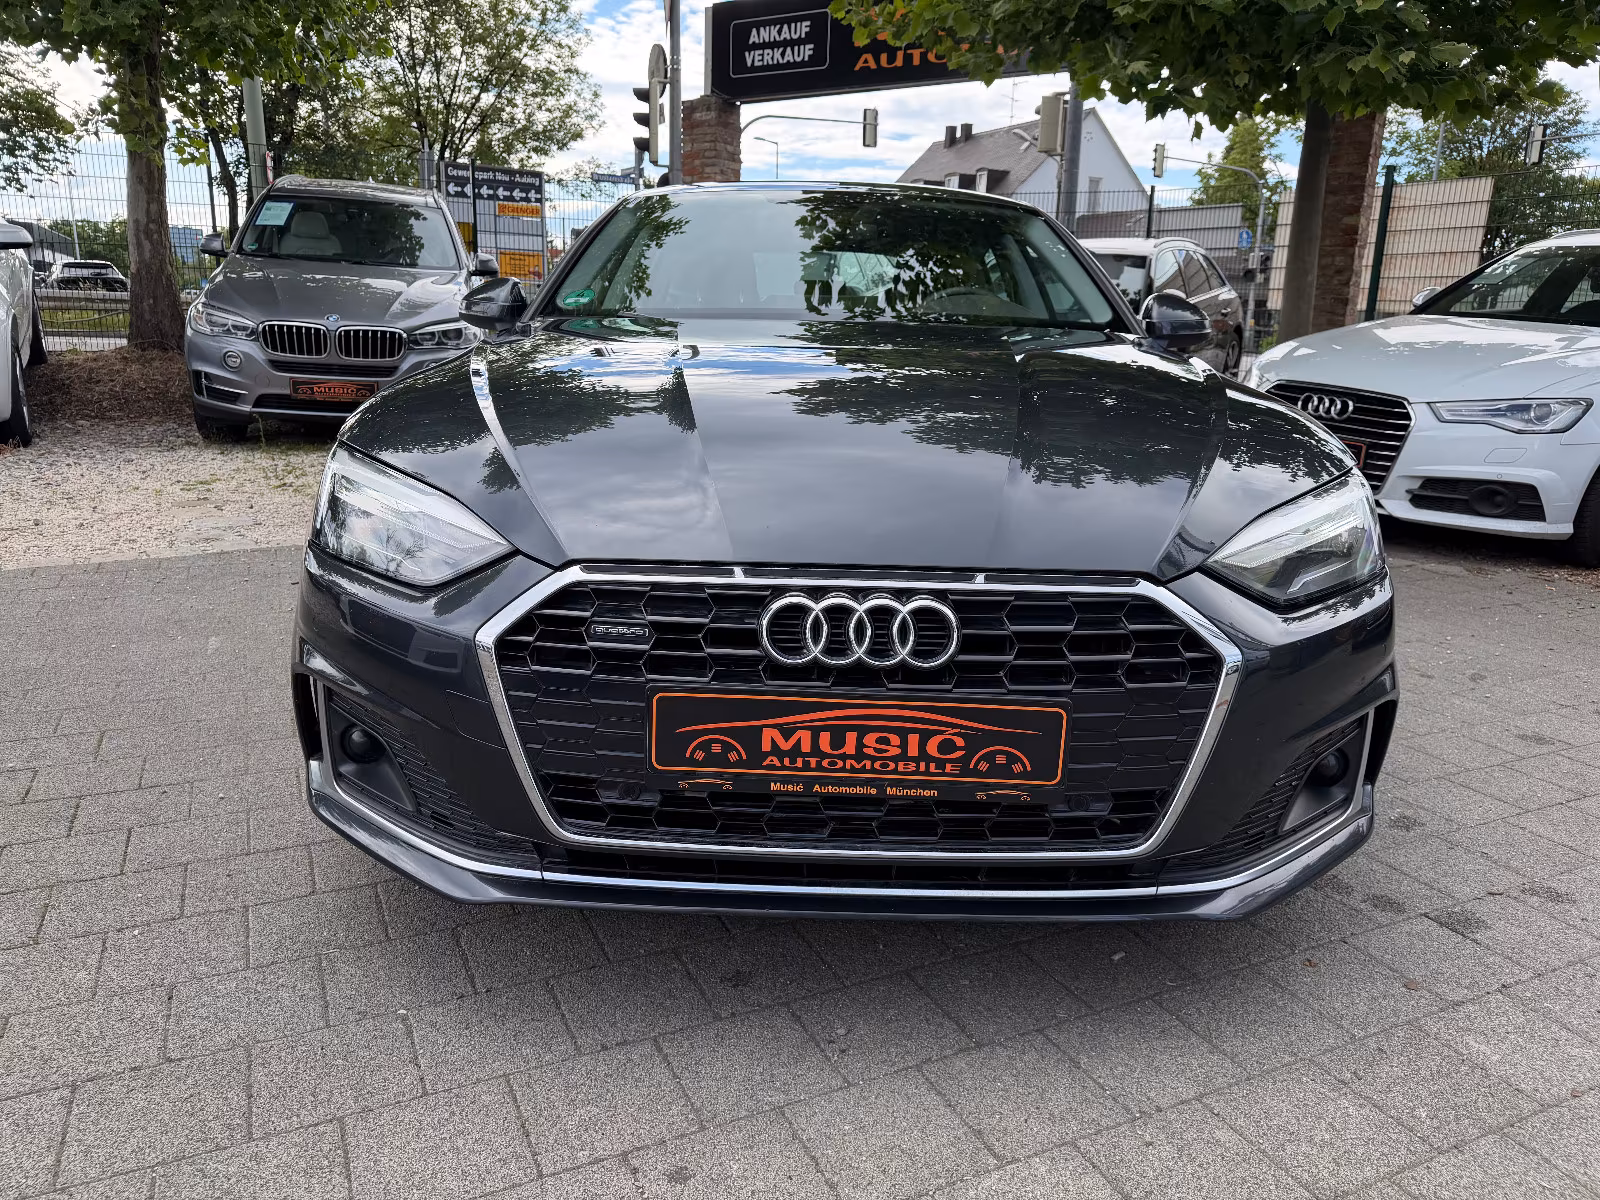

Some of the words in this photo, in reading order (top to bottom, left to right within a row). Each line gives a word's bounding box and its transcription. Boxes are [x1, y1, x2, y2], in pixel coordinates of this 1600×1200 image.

[748, 20, 811, 45] ANKAUF
[745, 43, 815, 68] VERKAUF
[761, 728, 966, 759] MUSIĆ
[761, 755, 963, 774] AUTOMOBILE
[770, 781, 804, 793] Musić
[812, 783, 877, 796] Automobile
[886, 785, 938, 798] München
